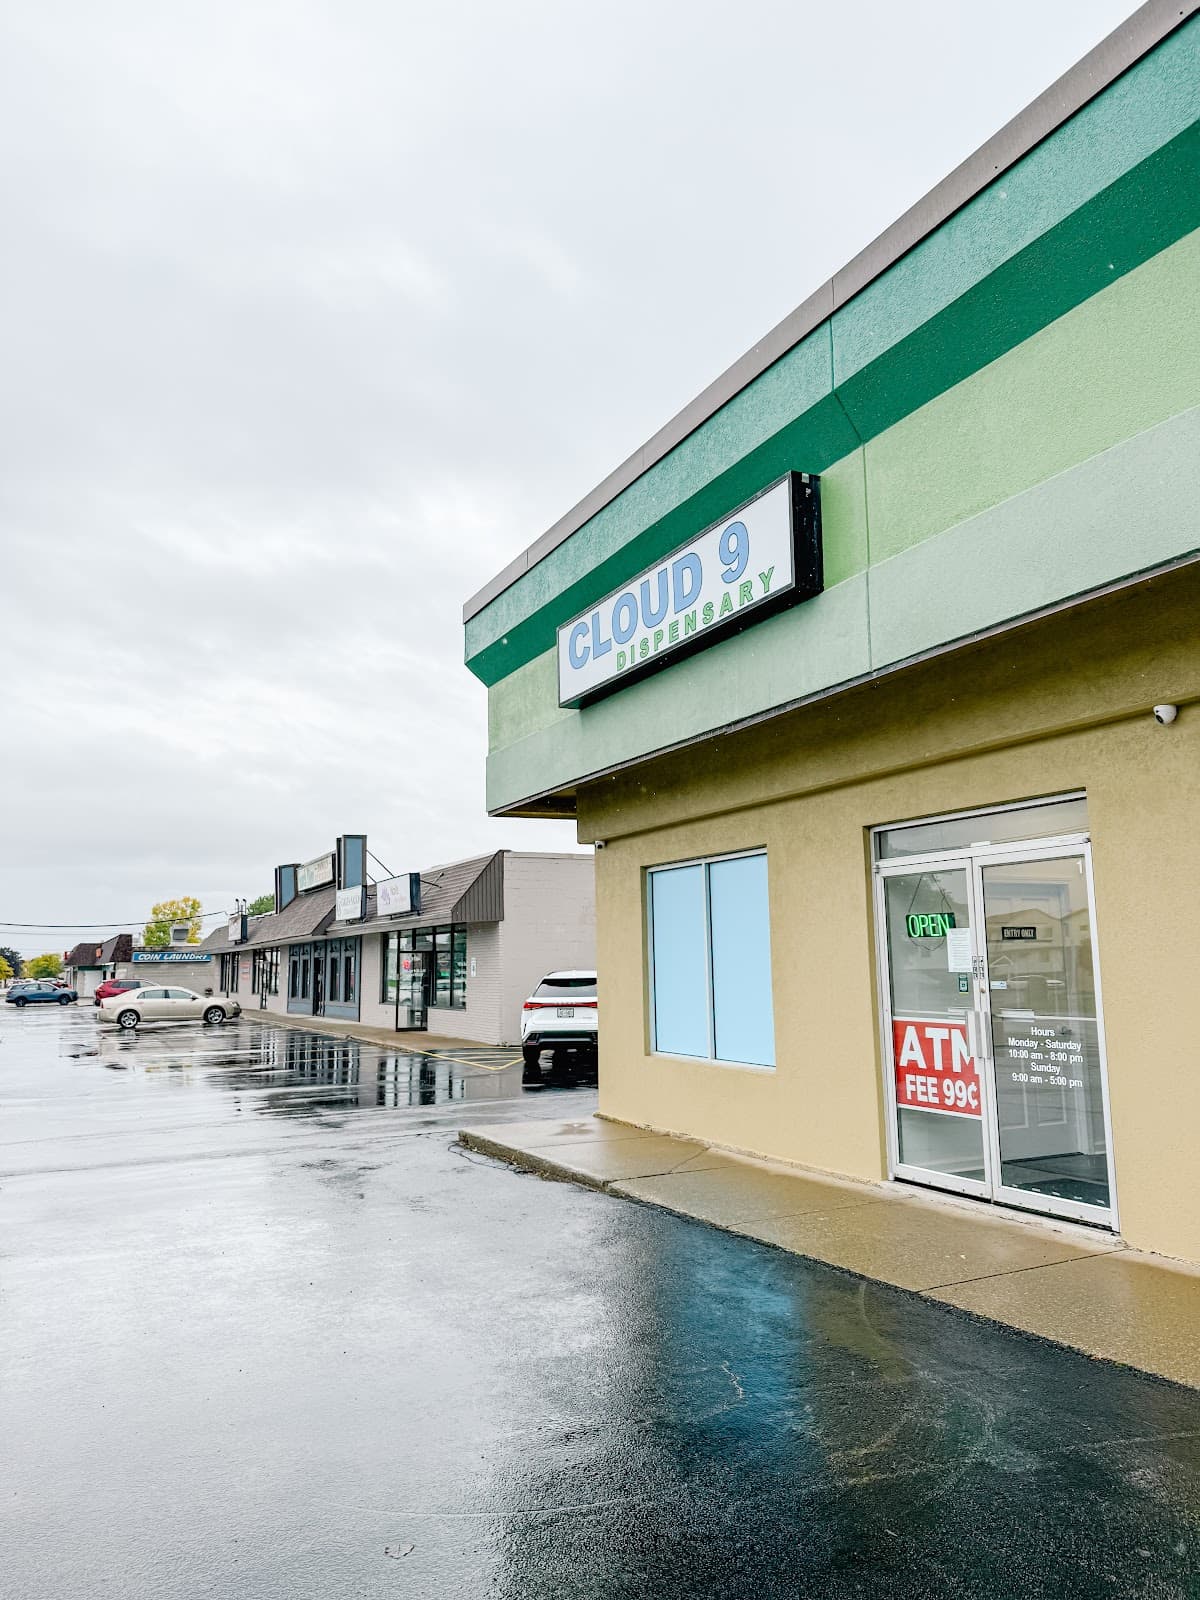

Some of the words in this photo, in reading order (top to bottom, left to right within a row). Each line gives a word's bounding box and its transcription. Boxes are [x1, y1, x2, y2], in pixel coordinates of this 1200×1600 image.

[568, 552, 703, 670] CLOUD
[719, 521, 749, 584] 9
[616, 566, 775, 672] DISPENSARY
[908, 914, 950, 938] OPEN
[1004, 929, 1020, 938] ENTRY
[1021, 929, 1034, 938] ONLY
[1031, 1027, 1055, 1036] Hours
[899, 1025, 980, 1075] ATM
[1008, 1037, 1039, 1049] Monday
[1045, 1039, 1082, 1052] Saturday
[1008, 1049, 1029, 1059] 10:00
[1030, 1052, 1043, 1060] am
[1050, 1051, 1067, 1061] 8:00
[1069, 1054, 1083, 1064] pm
[1031, 1062, 1061, 1075] Sunday
[1012, 1072, 1028, 1082] 9:00
[1030, 1075, 1043, 1084] am
[1050, 1076, 1067, 1086] 5:00
[1069, 1079, 1083, 1089] pm
[905, 1074, 939, 1104] FEE
[942, 1078, 978, 1109] 99¢
